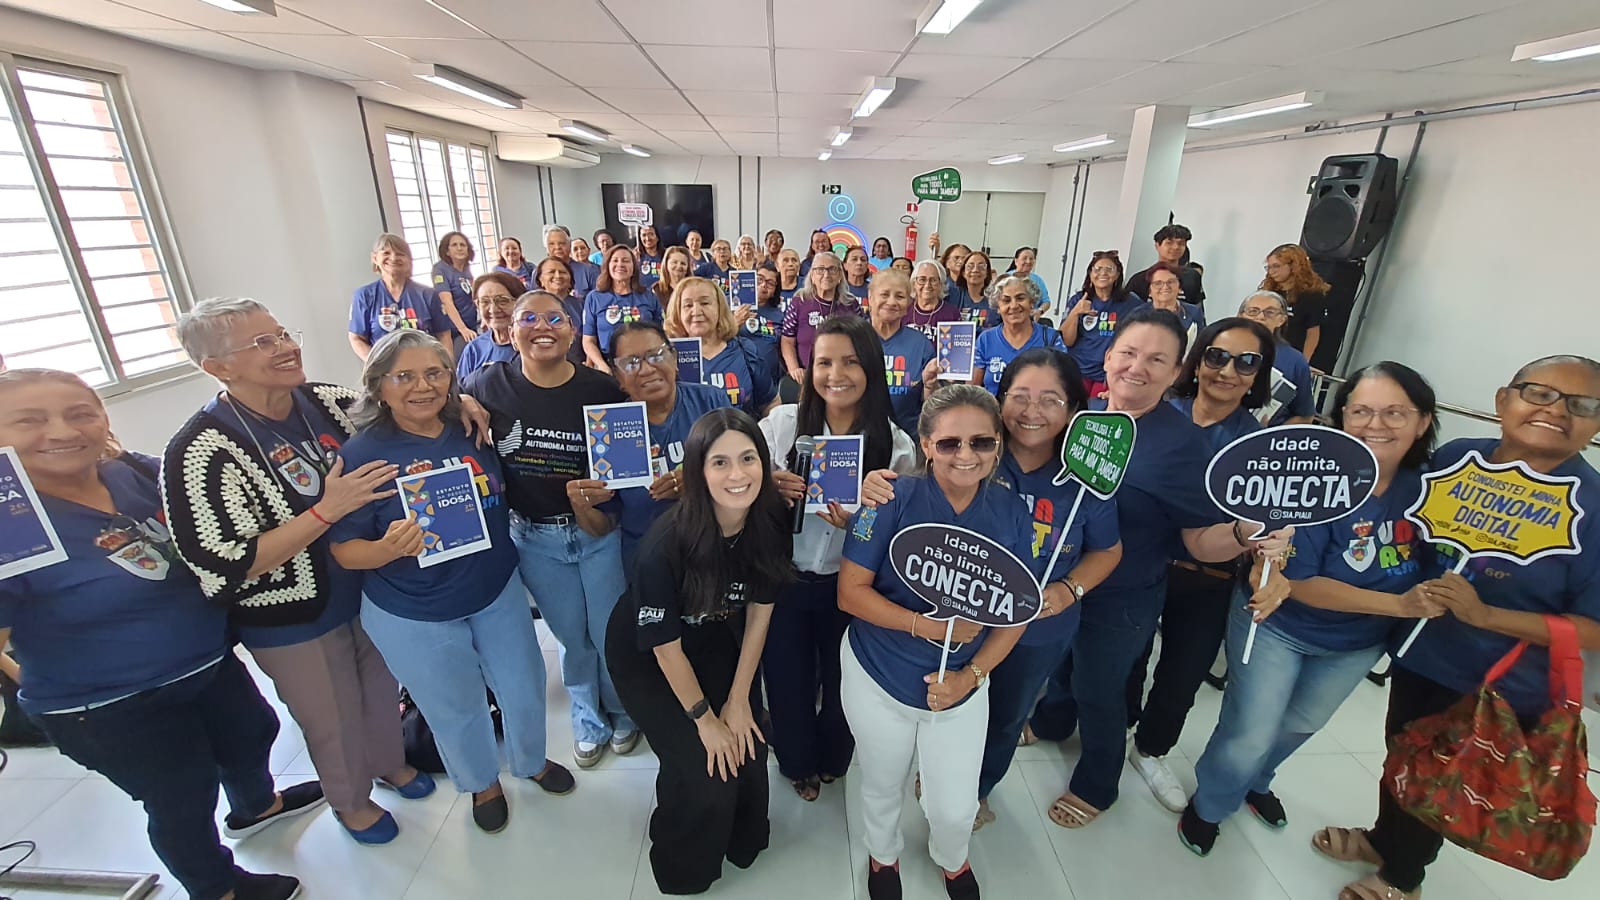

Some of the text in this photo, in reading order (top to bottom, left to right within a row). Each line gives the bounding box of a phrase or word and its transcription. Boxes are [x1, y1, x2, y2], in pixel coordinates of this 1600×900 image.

[526, 427, 583, 442] CAPACITIA
[613, 430, 643, 439] IDOSA
[1085, 419, 1109, 436] TECNOLOGIA
[525, 440, 565, 452] AUTONOMIA
[1078, 433, 1091, 447] PARA
[1091, 434, 1110, 456] TODOS
[1269, 437, 1321, 451] Idade
[1068, 442, 1087, 463] PARA
[1084, 451, 1099, 470] MIM
[1247, 456, 1340, 472] não limita,
[436, 483, 469, 495] ESTATUTO
[437, 493, 473, 508] IDOSA
[1225, 475, 1351, 508] CONECTA
[1467, 471, 1562, 507] CONQUISTEI MINHA
[1447, 480, 1561, 529] AUTONOMIA
[1453, 505, 1521, 540] DIGITAL
[944, 533, 989, 560] Idade
[924, 545, 1007, 588] não limita,
[905, 554, 1014, 622] CONECTA
